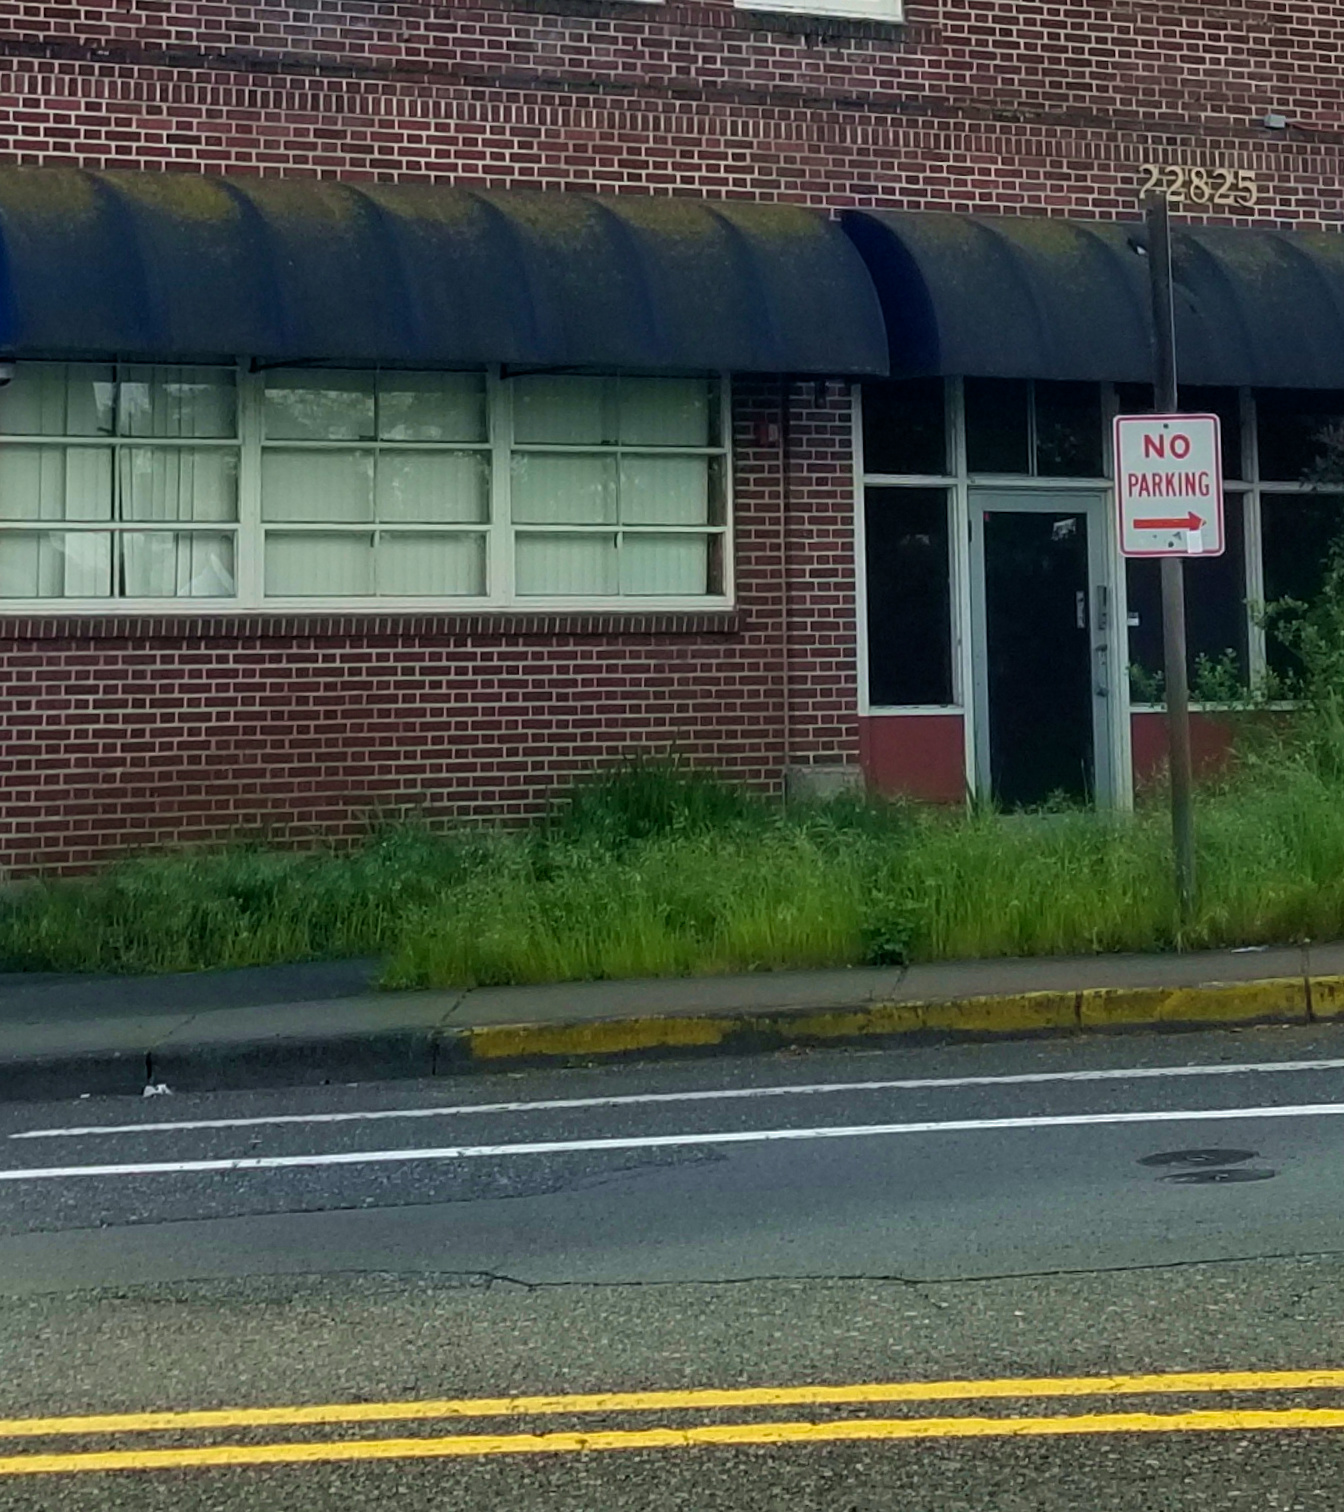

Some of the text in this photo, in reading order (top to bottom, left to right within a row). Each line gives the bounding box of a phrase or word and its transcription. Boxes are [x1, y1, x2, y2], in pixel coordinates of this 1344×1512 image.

[1139, 164, 1257, 206] 22825
[1144, 433, 1191, 460] NO
[1128, 471, 1210, 497] PARKING
